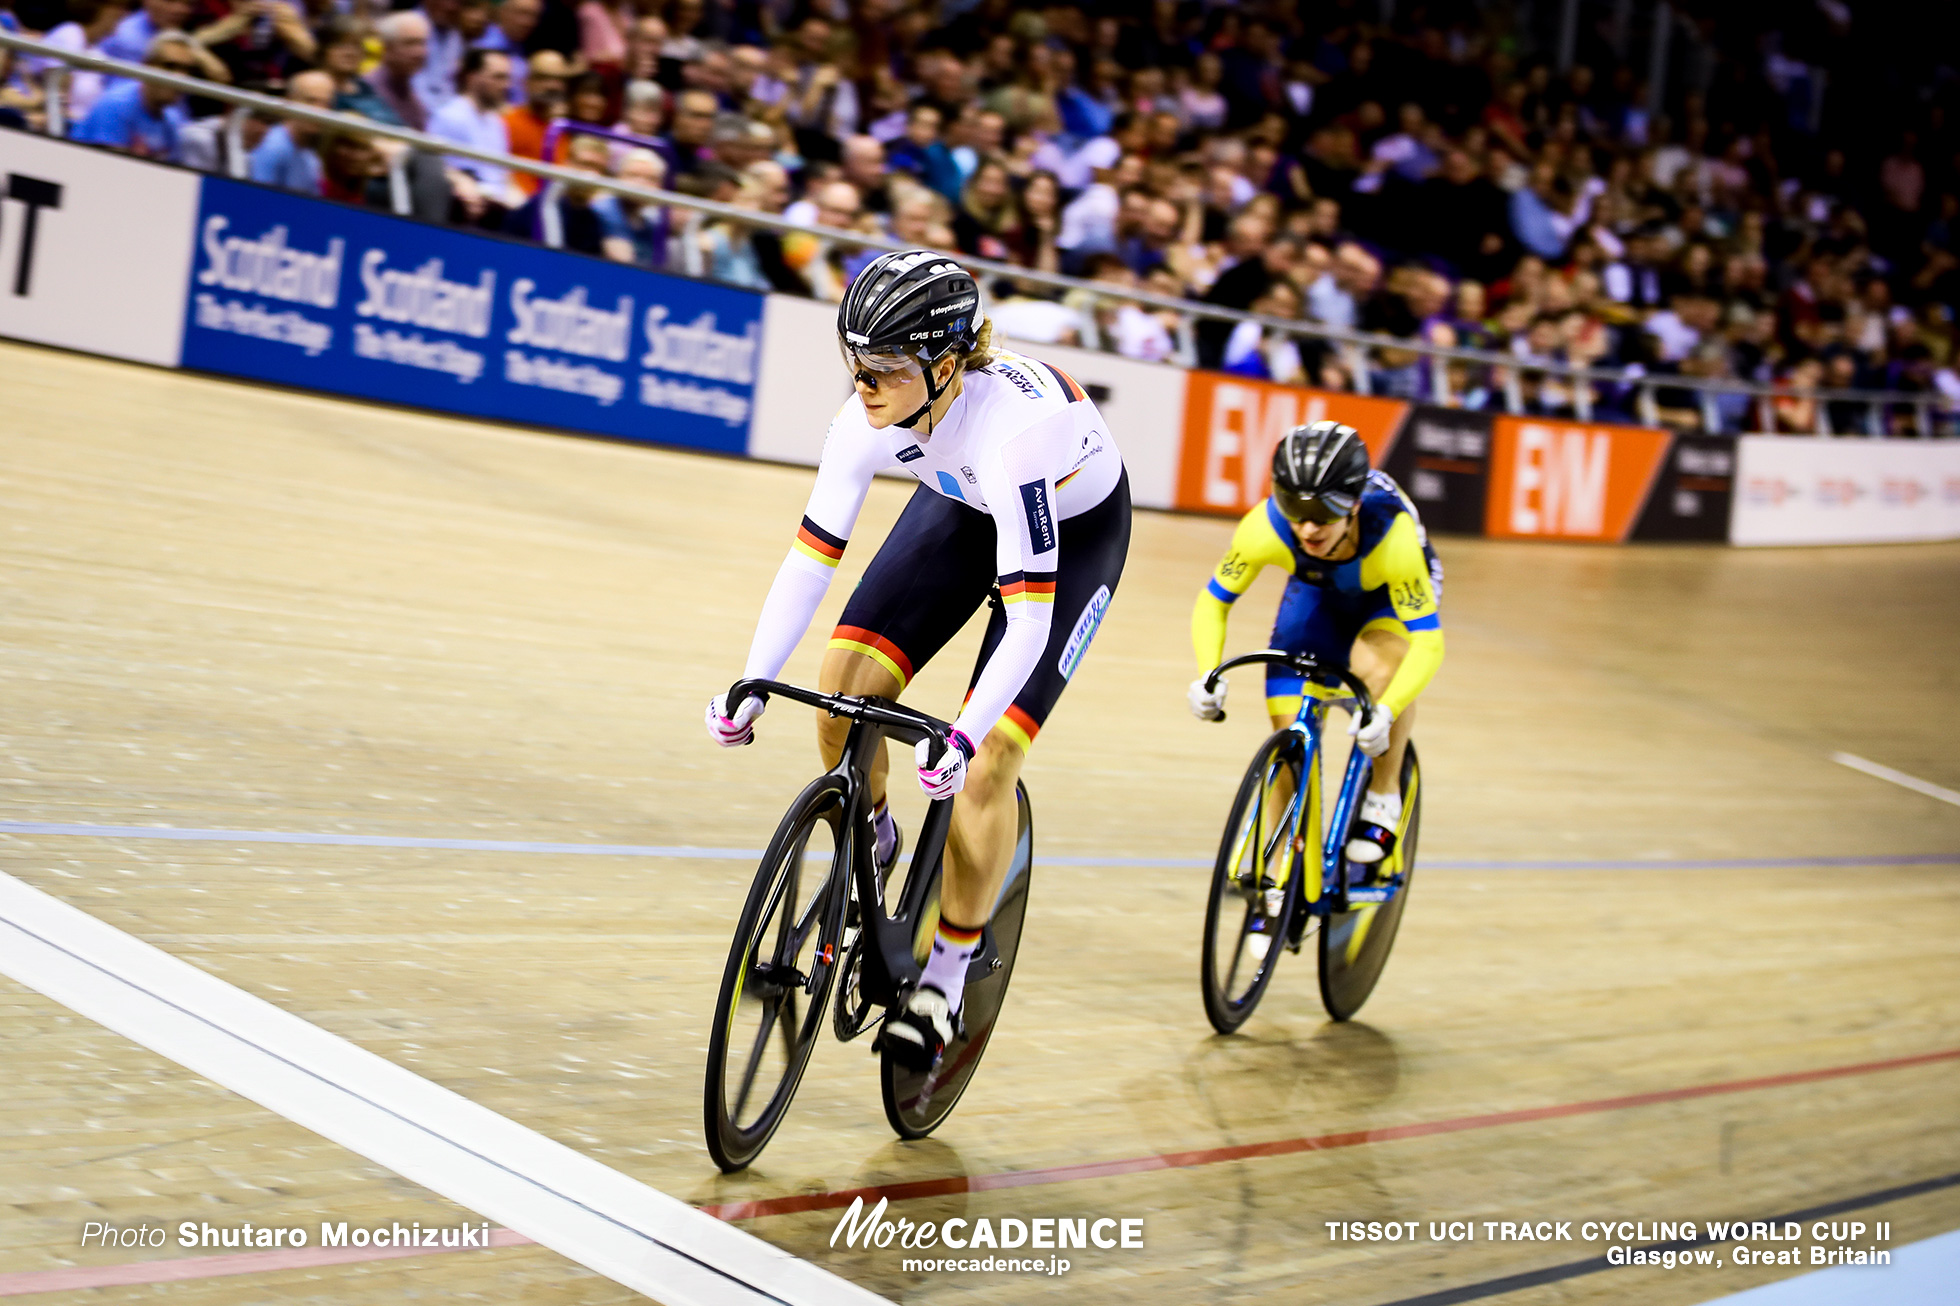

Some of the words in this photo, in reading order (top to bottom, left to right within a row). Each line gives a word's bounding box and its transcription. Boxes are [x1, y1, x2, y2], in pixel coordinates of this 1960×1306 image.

[199, 214, 345, 309] Scotland
[356, 249, 496, 338] Scotland
[506, 278, 635, 362] Scotland
[640, 304, 760, 385] Scotland
[1034, 487, 1052, 547] AviaRent
